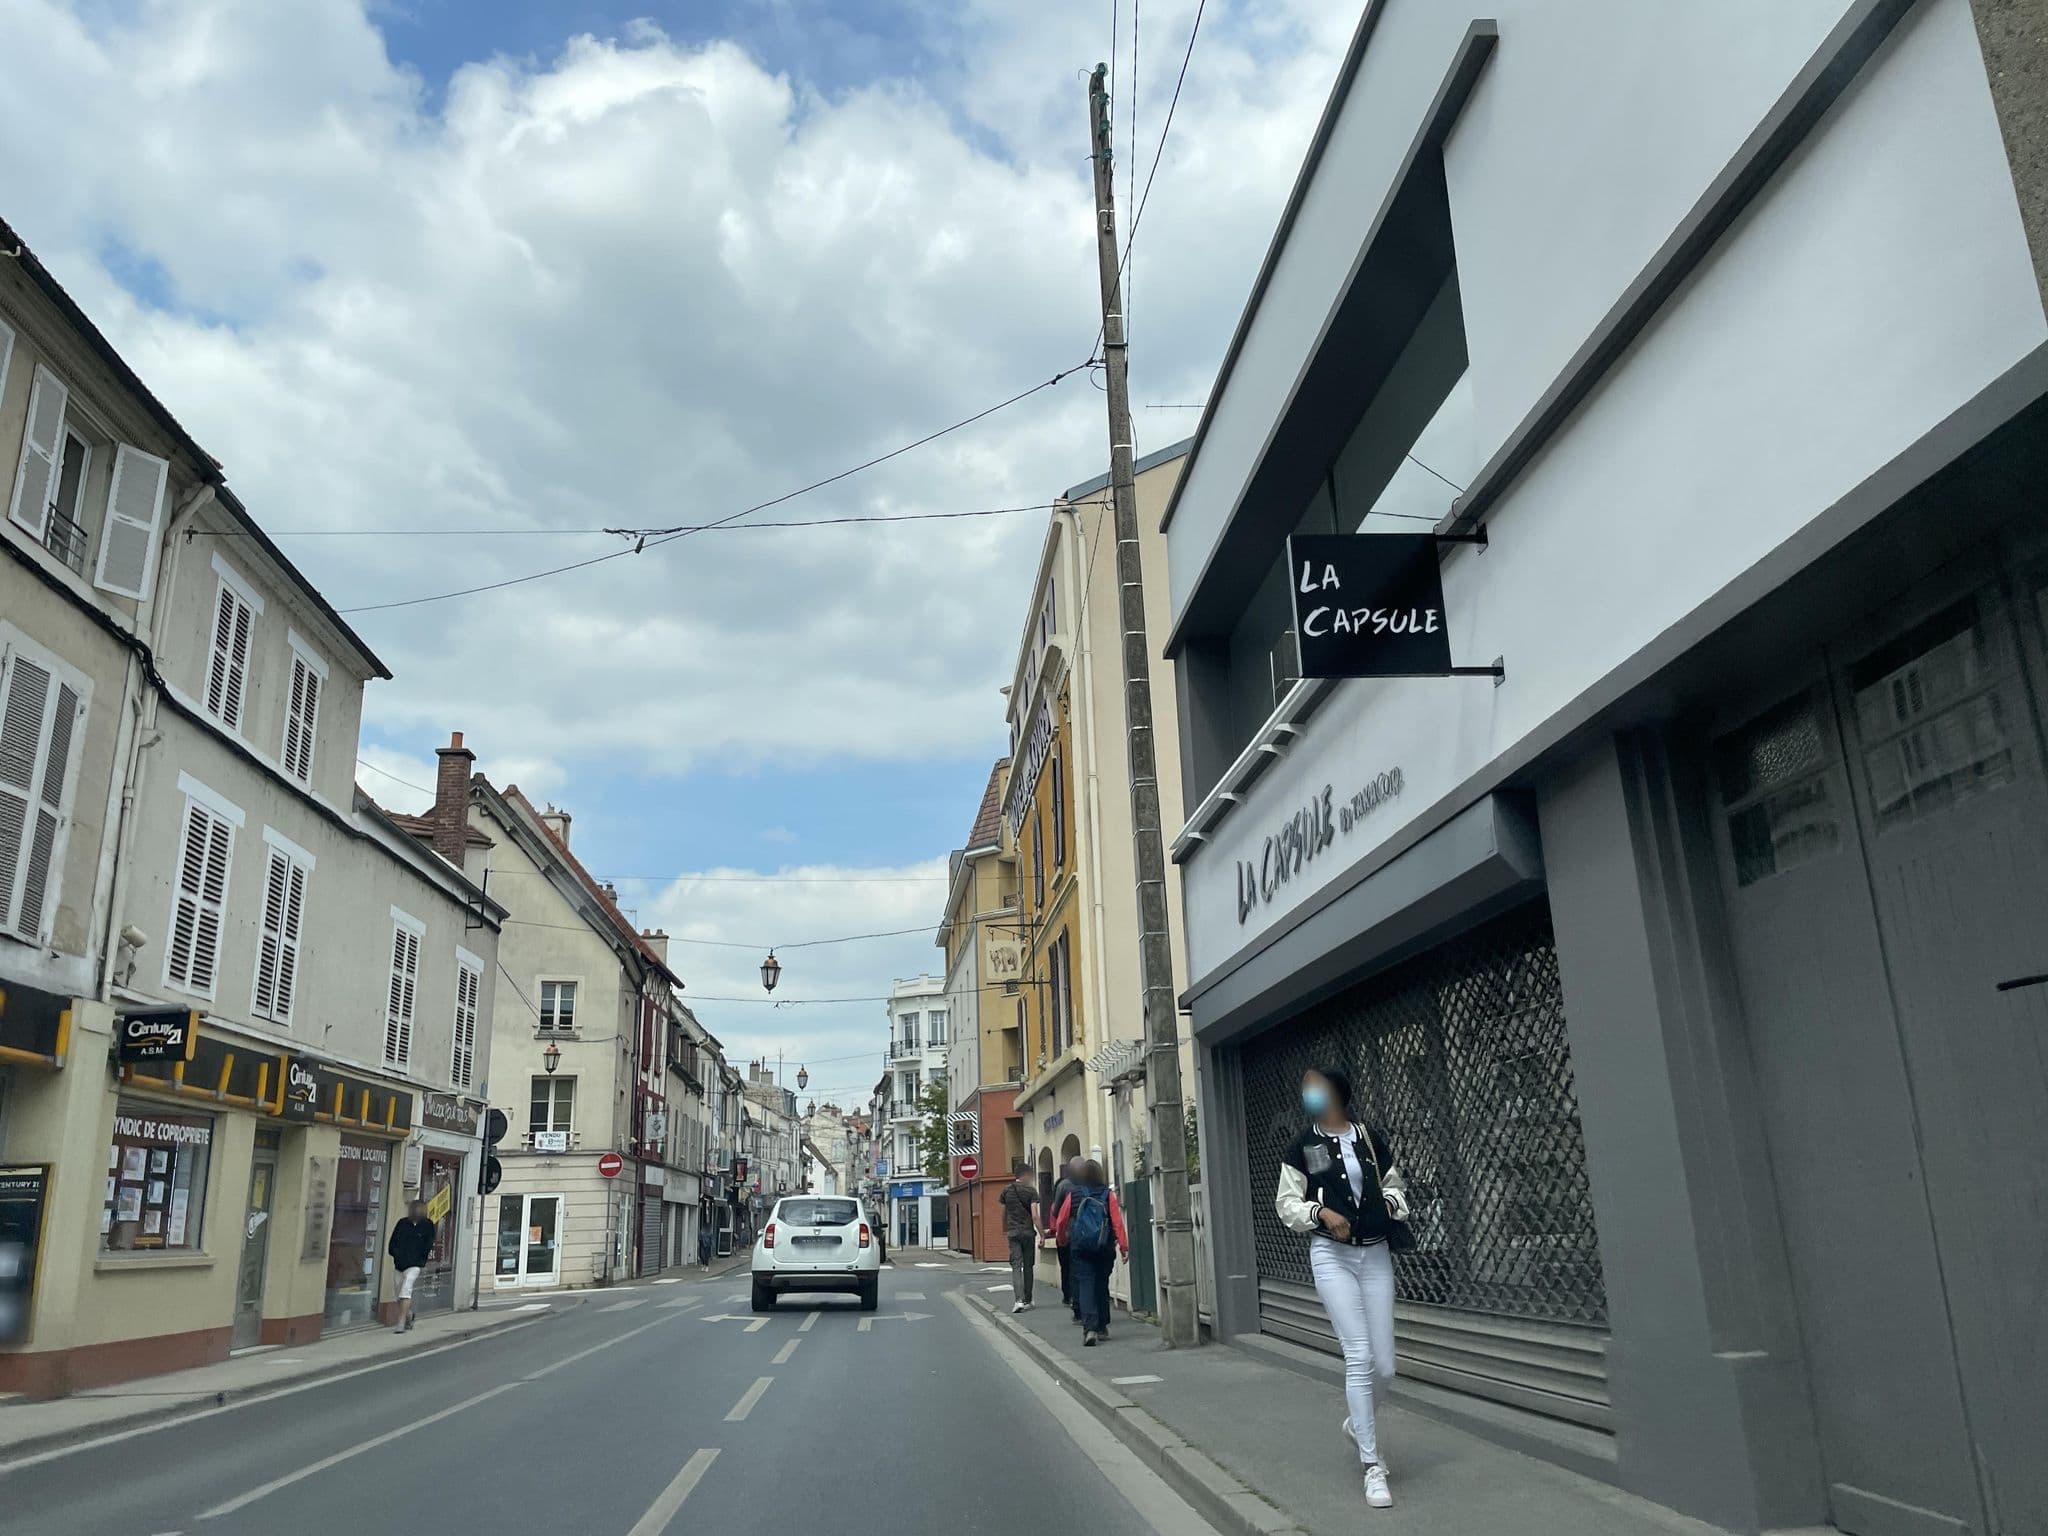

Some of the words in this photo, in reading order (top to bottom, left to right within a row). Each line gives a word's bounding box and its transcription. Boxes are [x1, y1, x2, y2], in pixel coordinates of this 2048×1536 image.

[1300, 561, 1341, 593] LA
[1303, 606, 1440, 637] CAPSULE
[1237, 860, 1257, 926] LA
[1260, 783, 1335, 903] CAPSULE
[128, 1020, 175, 1037] Century
[166, 1028, 183, 1045] 21
[308, 1083, 317, 1103] 21
[115, 1116, 142, 1137] YNDIC
[143, 1121, 156, 1139] DE
